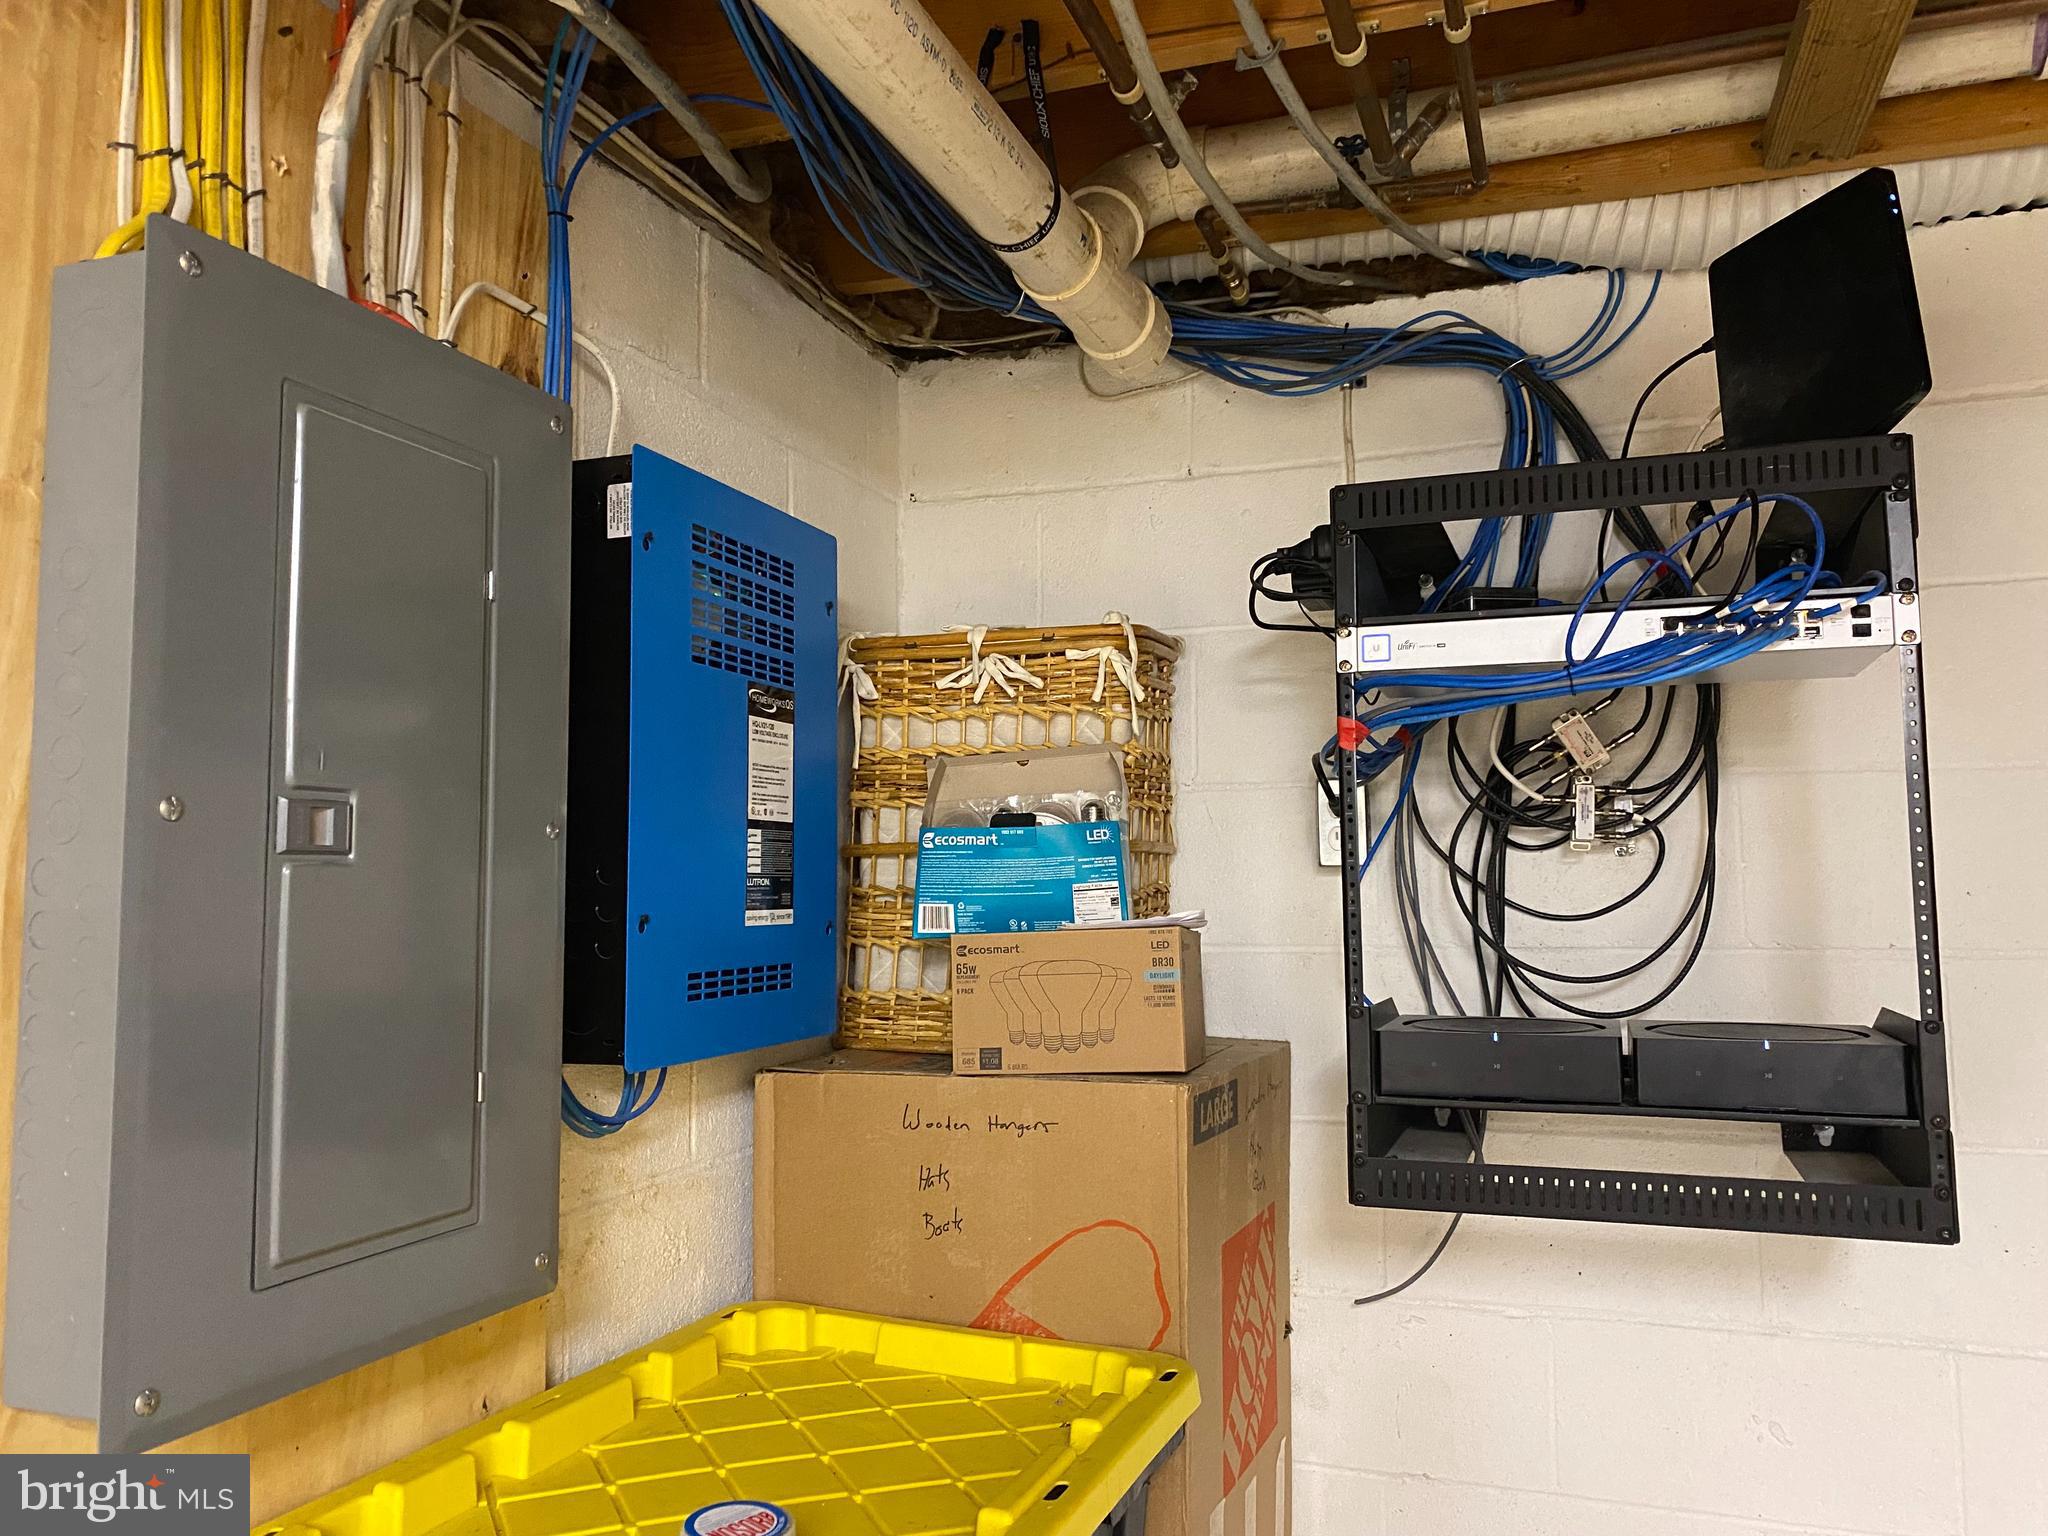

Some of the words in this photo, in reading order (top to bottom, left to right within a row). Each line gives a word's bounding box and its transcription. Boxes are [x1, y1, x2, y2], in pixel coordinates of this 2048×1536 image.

[1028, 68, 1044, 100] CHIEF
[1034, 100, 1051, 140] SIOUX
[1011, 233, 1041, 253] CHIEF
[934, 832, 999, 847] ecosmart
[1086, 828, 1110, 841] LED
[746, 878, 770, 886] LUTRON
[967, 943, 1020, 956] ecosmart
[1150, 940, 1170, 950] LED
[1151, 956, 1175, 968] BR30
[1149, 971, 1175, 980] DAYLIGHT
[902, 1103, 970, 1131] Wooden
[1199, 1090, 1235, 1132] LARGE
[918, 1163, 950, 1192] Hats
